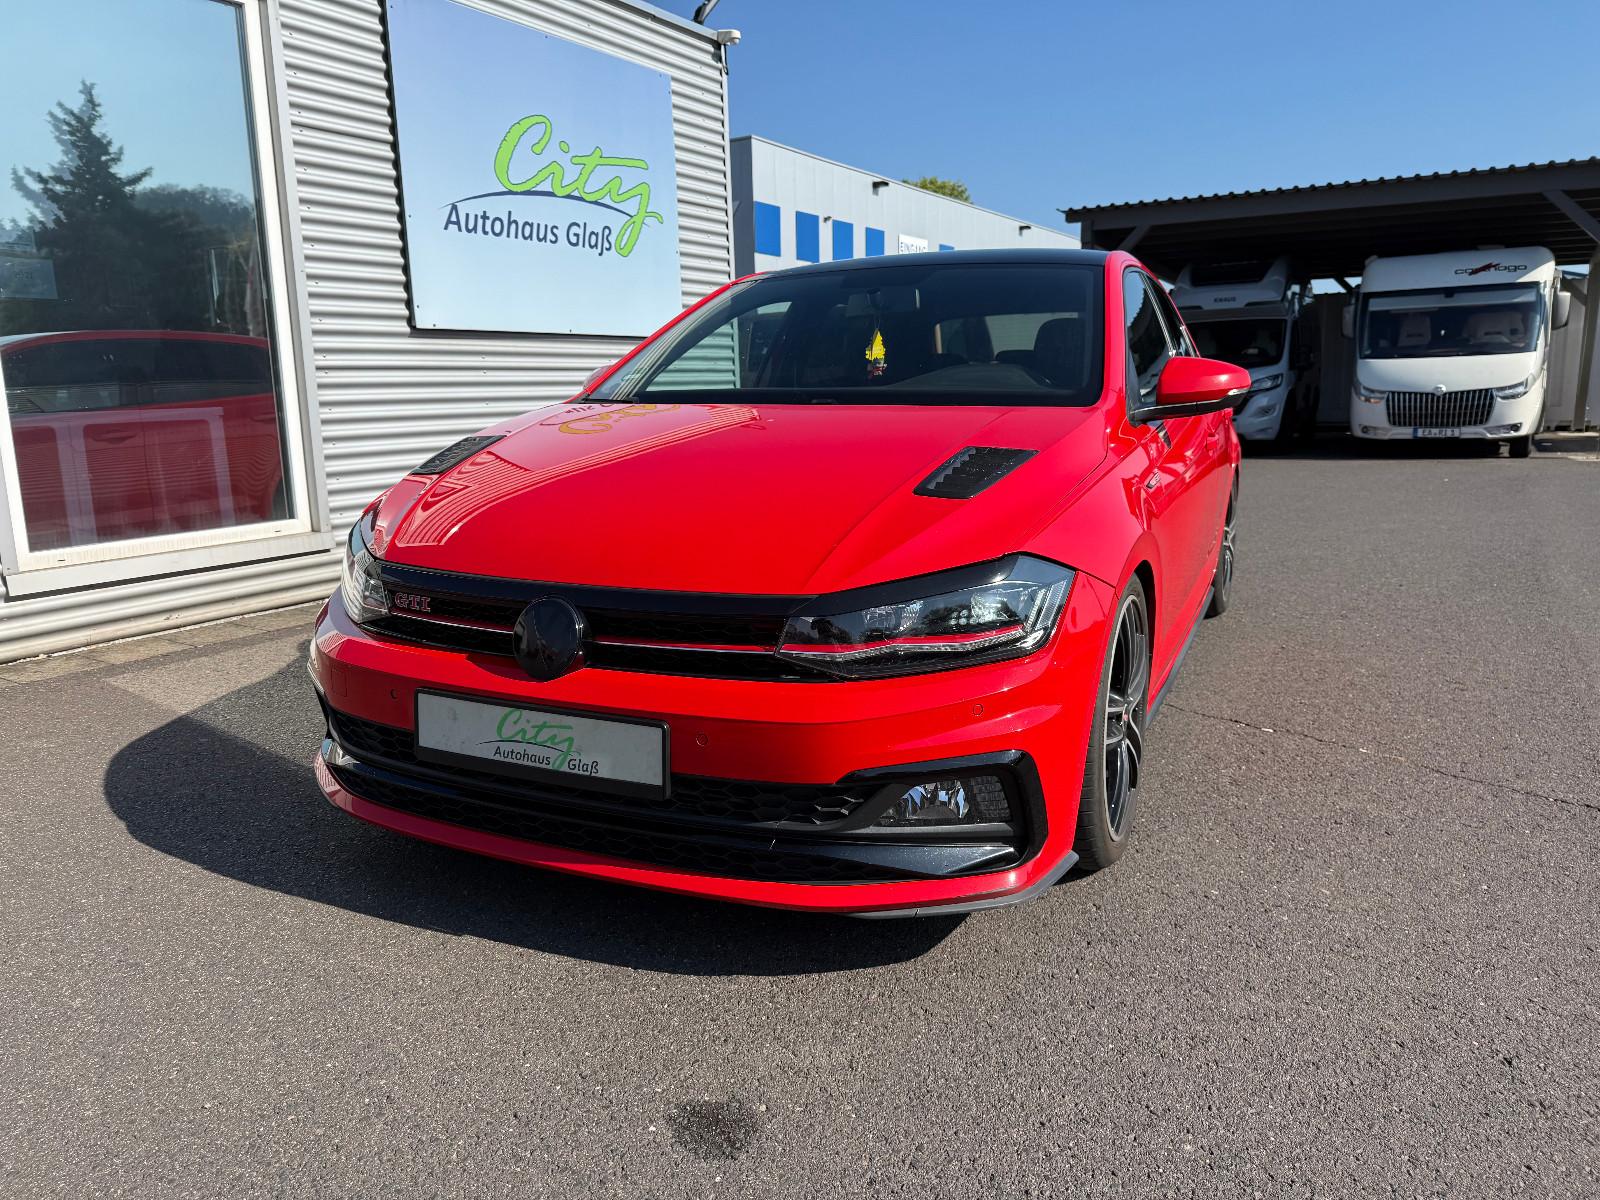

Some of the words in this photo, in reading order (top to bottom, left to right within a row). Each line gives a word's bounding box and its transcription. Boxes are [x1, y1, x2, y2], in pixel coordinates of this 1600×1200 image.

[493, 114, 664, 258] City
[443, 203, 560, 244] Autohaus
[565, 221, 613, 257] Glaß
[1454, 263, 1528, 276] cahago
[394, 592, 431, 612] GTI
[493, 745, 551, 766] Autohaus
[567, 758, 600, 776] Glaß
[496, 708, 582, 772] City
